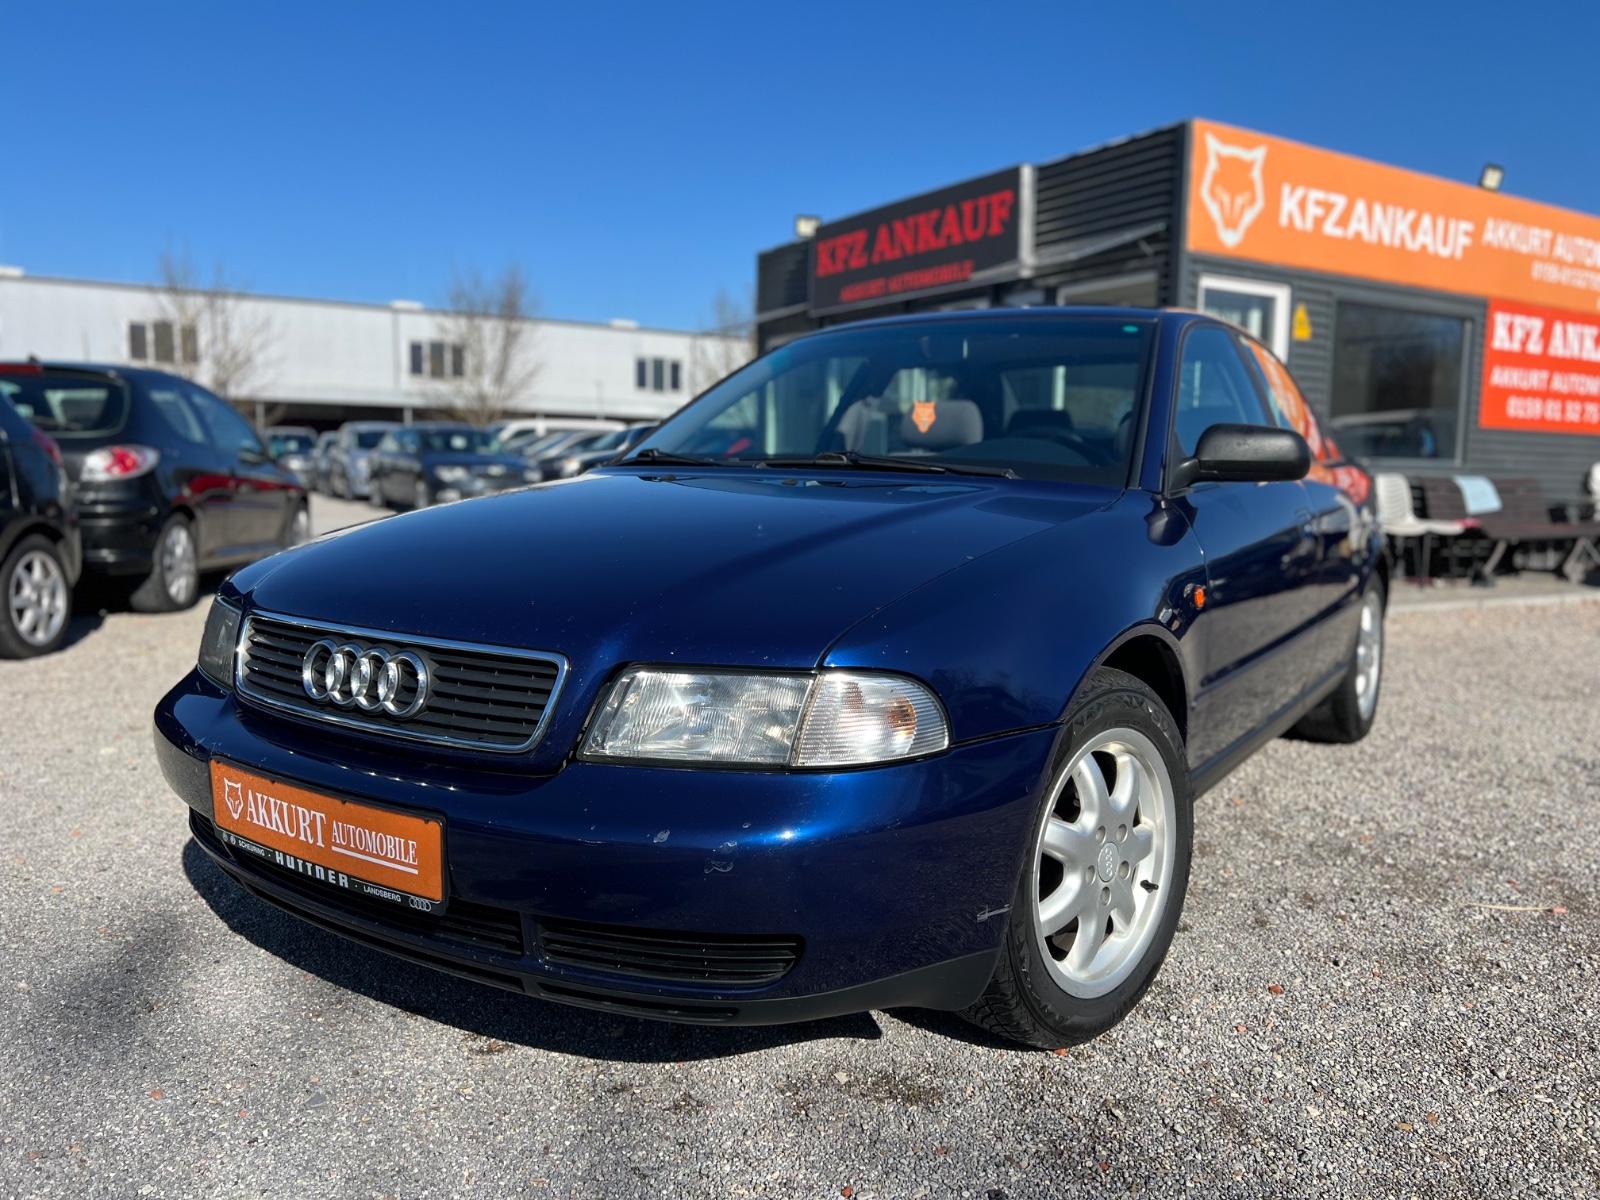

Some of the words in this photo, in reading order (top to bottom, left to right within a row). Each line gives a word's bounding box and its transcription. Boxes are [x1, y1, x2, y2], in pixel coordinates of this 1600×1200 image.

[815, 228, 868, 277] KFZ
[872, 189, 1015, 264] ANKAUF
[1482, 216, 1552, 257] AKKURT
[1491, 311, 1545, 355] KFZ
[1488, 365, 1550, 392] AKKURT
[246, 789, 327, 848] AKKURT
[331, 819, 418, 866] AUTOMOBILE
[363, 885, 402, 903] LANDSBERG
